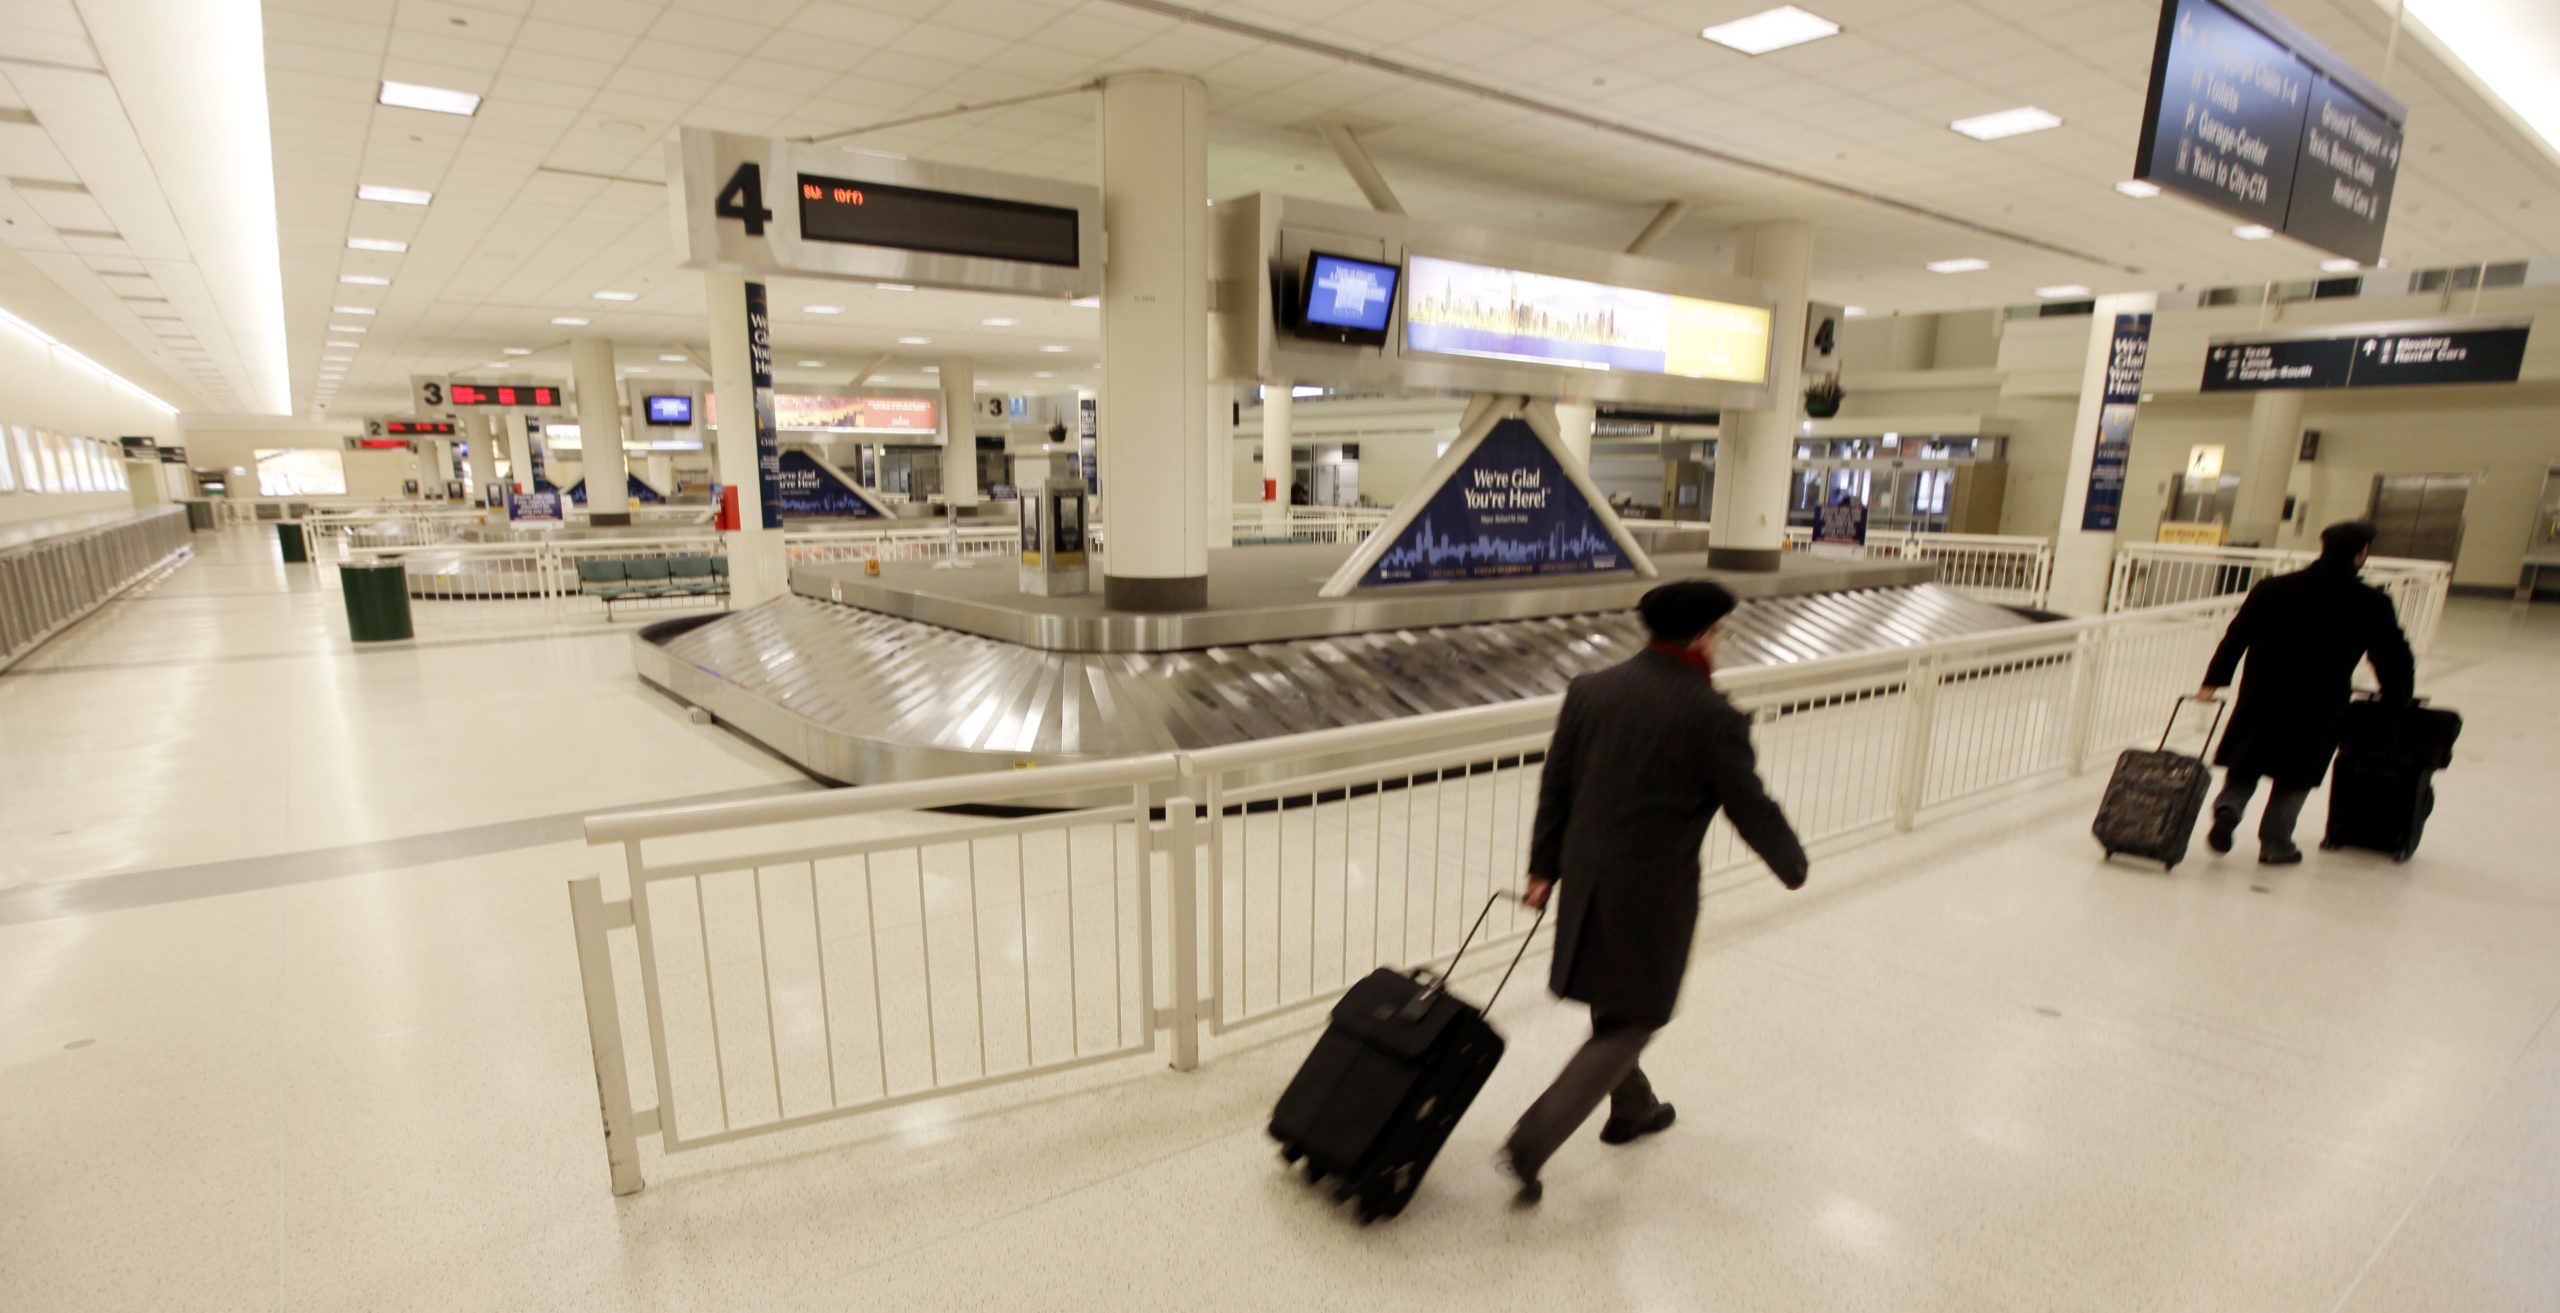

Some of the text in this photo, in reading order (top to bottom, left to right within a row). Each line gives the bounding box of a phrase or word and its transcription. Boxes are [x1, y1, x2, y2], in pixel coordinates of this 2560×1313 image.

[2206, 70, 2239, 113] Toilets
[2198, 108, 2269, 167] Garage-Center
[2192, 145, 2268, 205] Train to City-CTA
[715, 161, 773, 237] 4
[1814, 317, 1835, 357] 4
[422, 382, 443, 405] 3
[990, 398, 1003, 418] 3
[370, 421, 382, 436] 2
[1597, 423, 1652, 436] Information
[1474, 467, 1540, 489] We're Glad
[1465, 487, 1546, 510] You're Here!
